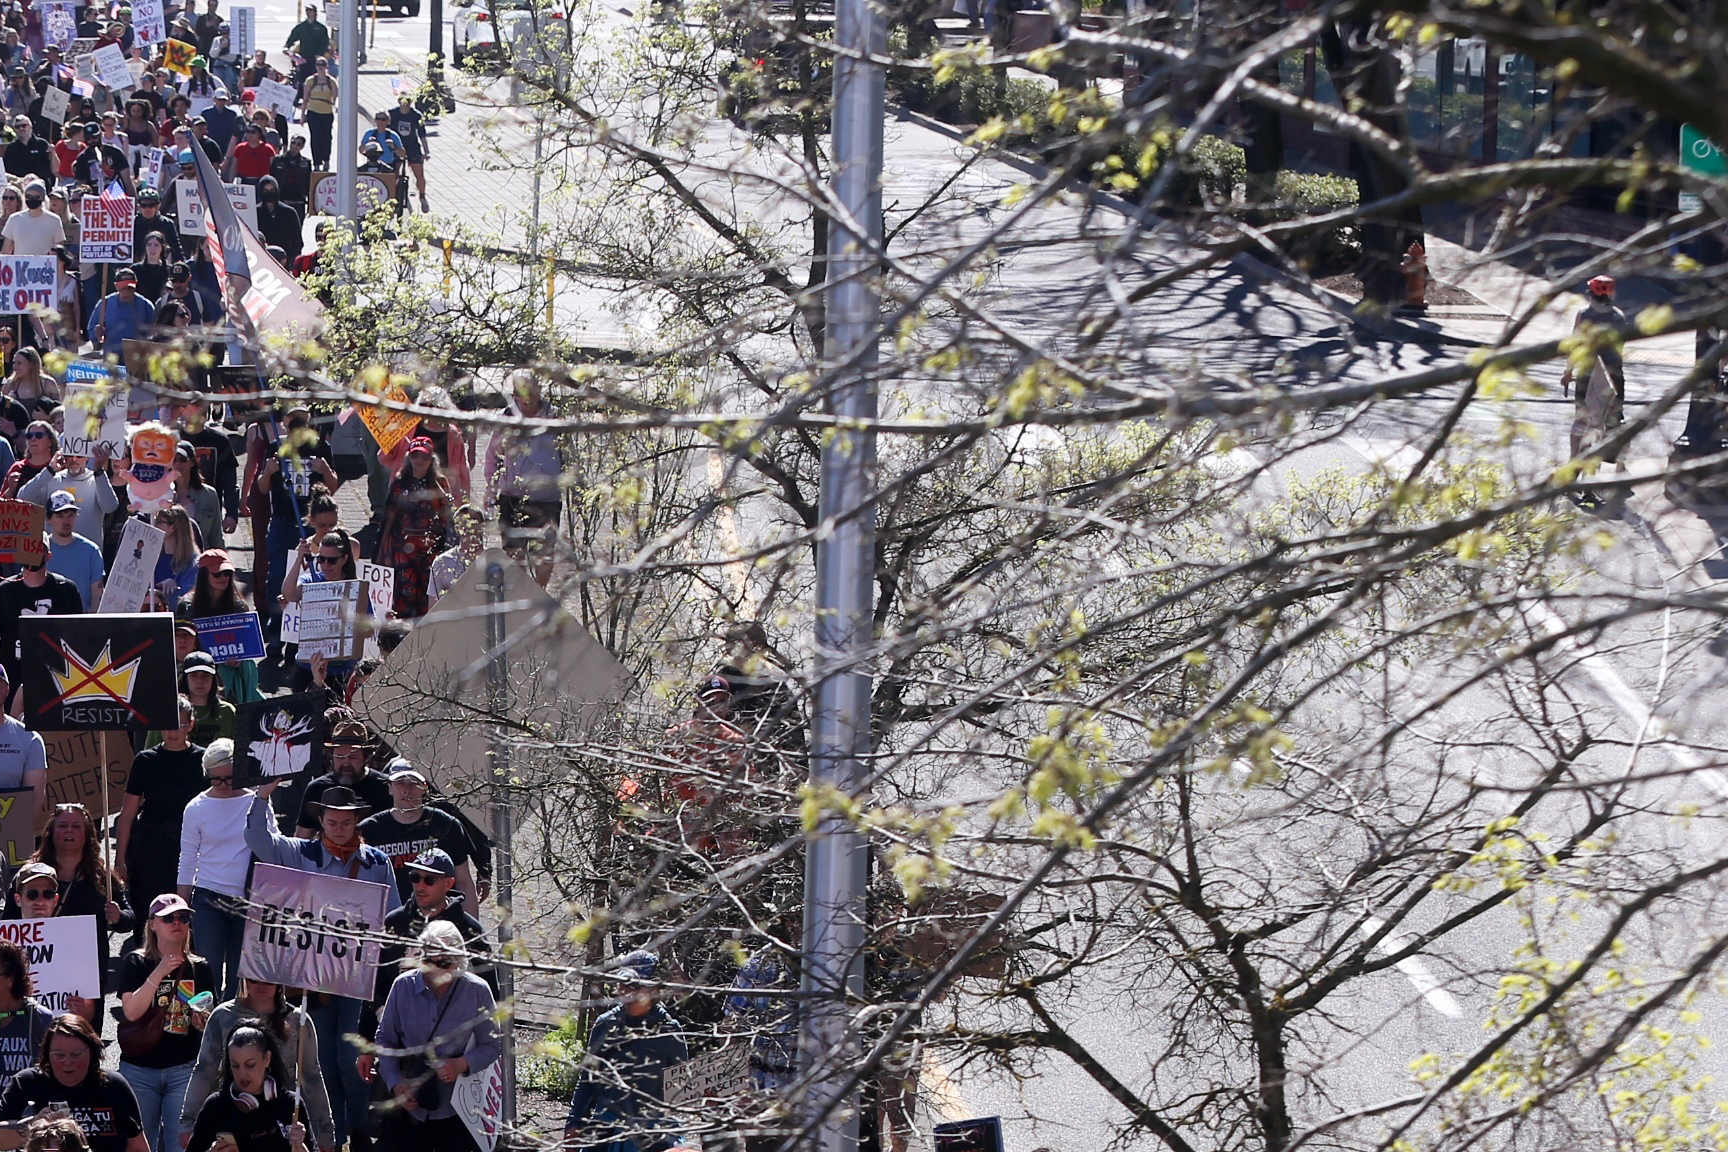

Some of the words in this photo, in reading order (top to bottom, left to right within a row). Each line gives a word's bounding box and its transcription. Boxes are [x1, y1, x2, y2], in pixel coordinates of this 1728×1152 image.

[83, 212, 108, 228] THE
[82, 231, 132, 242] PERMIT!
[16, 260, 56, 287] KINGS
[14, 290, 52, 311] OUT
[64, 437, 89, 454] NOT
[23, 538, 44, 554] USA
[363, 564, 392, 588] FOR
[209, 642, 245, 657] FUCK
[258, 904, 370, 962] RESIST
[9, 1054, 32, 1070] WAY
[94, 1112, 110, 1122] TU
